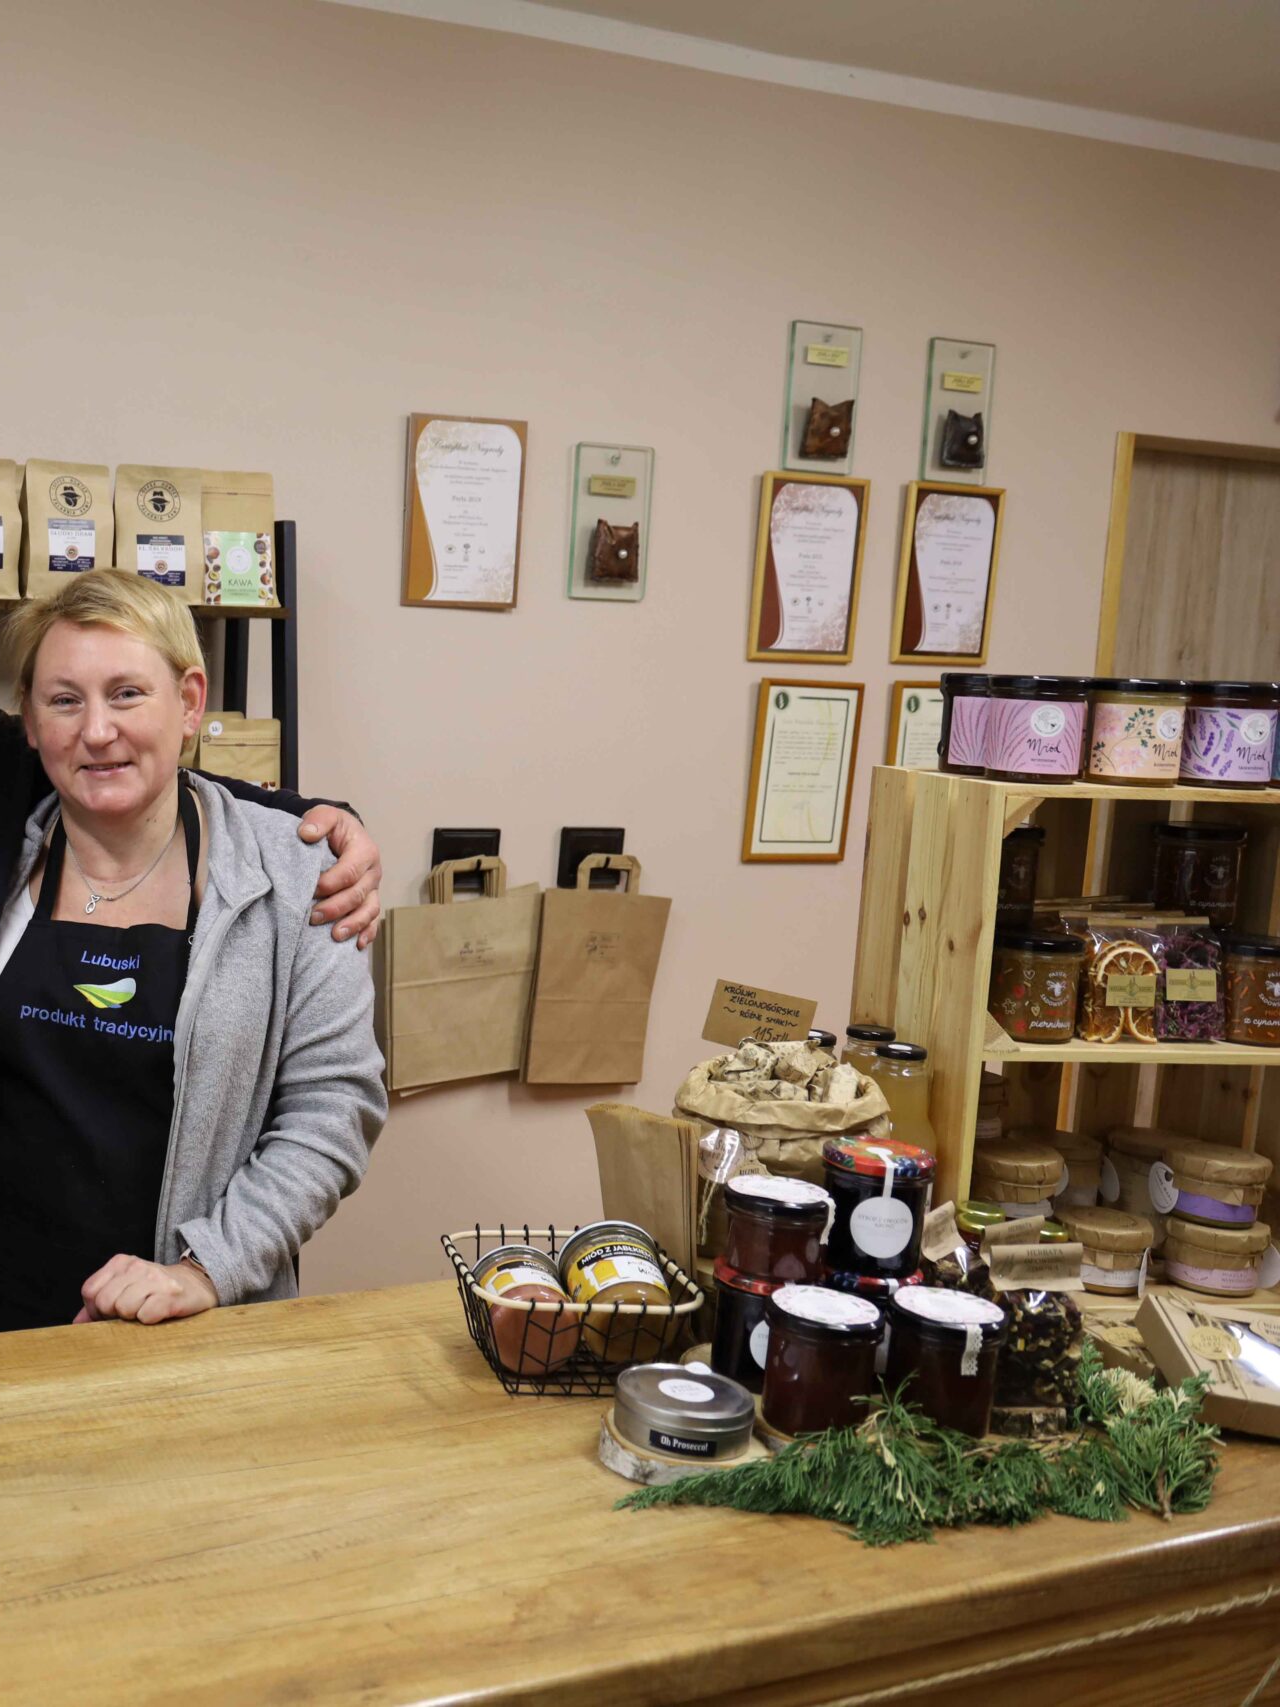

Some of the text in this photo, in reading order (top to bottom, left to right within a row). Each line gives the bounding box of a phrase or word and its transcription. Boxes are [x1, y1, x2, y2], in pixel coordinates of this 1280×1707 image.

[228, 578, 253, 587] KAWA
[80, 950, 141, 970] Lubuski
[20, 1004, 175, 1043] produkt tradycyjn
[1252, 1017, 1280, 1030] cynam
[660, 1435, 709, 1453] Oh Prosecco!
